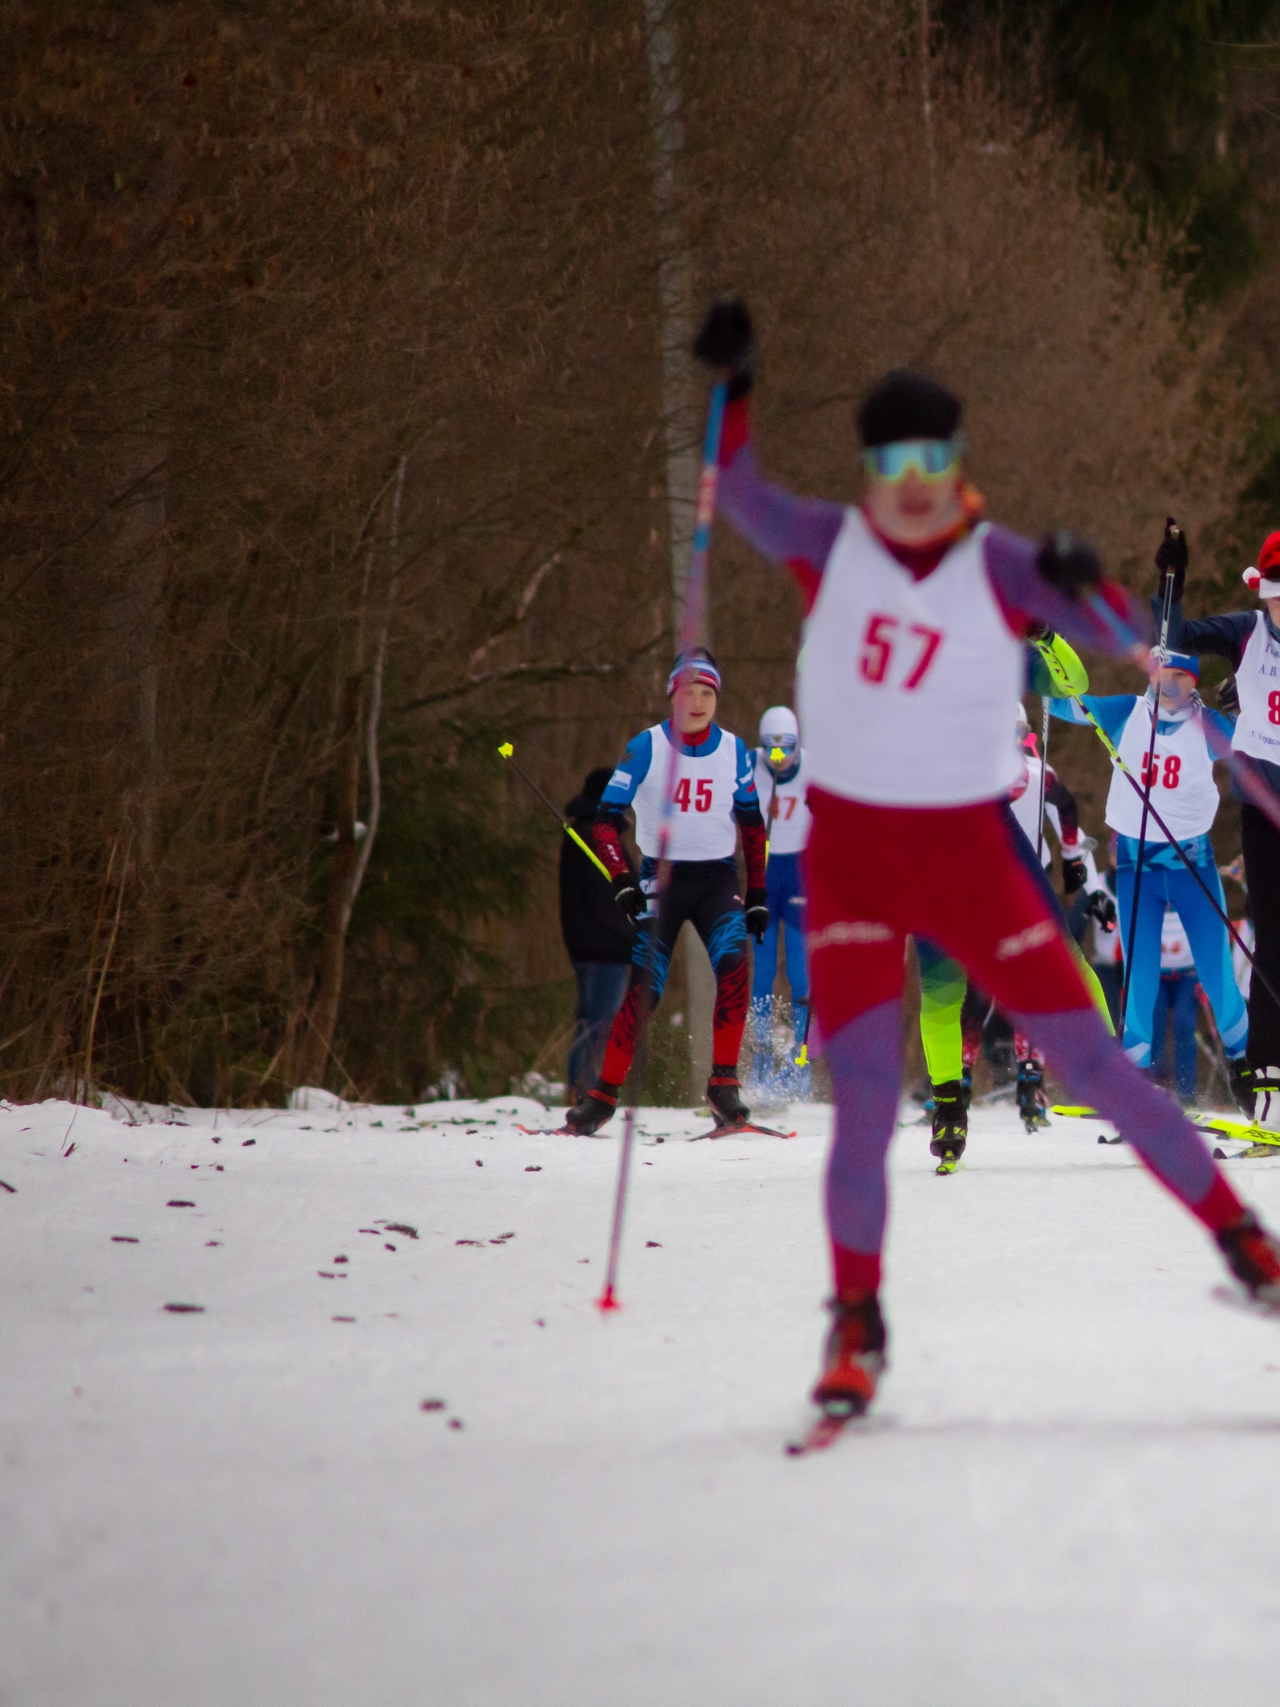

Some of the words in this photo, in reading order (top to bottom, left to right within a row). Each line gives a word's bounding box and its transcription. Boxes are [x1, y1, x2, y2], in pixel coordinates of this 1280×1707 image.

[860, 611, 946, 691] 57
[1141, 751, 1182, 790] 58
[672, 777, 714, 813] 45
[766, 796, 797, 821] 47
